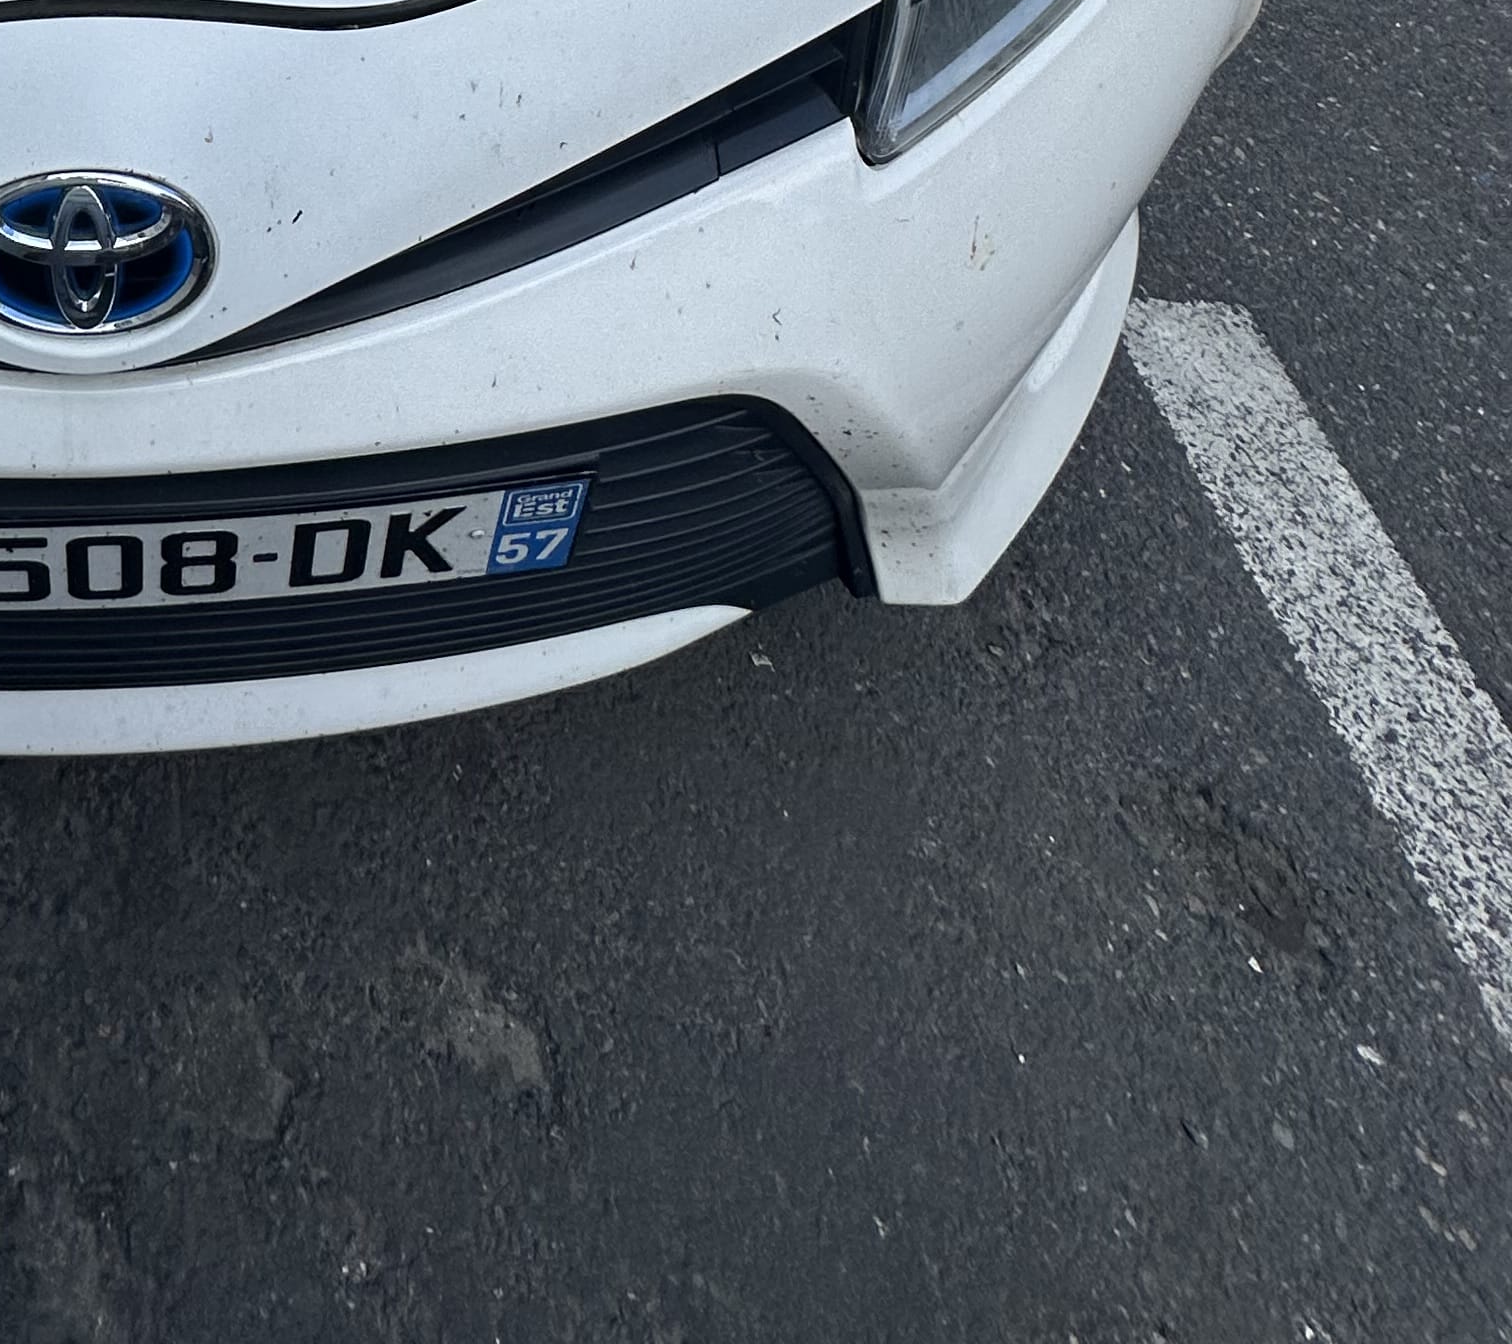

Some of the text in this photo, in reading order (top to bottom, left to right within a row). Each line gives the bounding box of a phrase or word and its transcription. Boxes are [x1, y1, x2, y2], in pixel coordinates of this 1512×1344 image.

[517, 489, 573, 503] Grand
[513, 499, 569, 518] Est
[495, 528, 569, 564] 57
